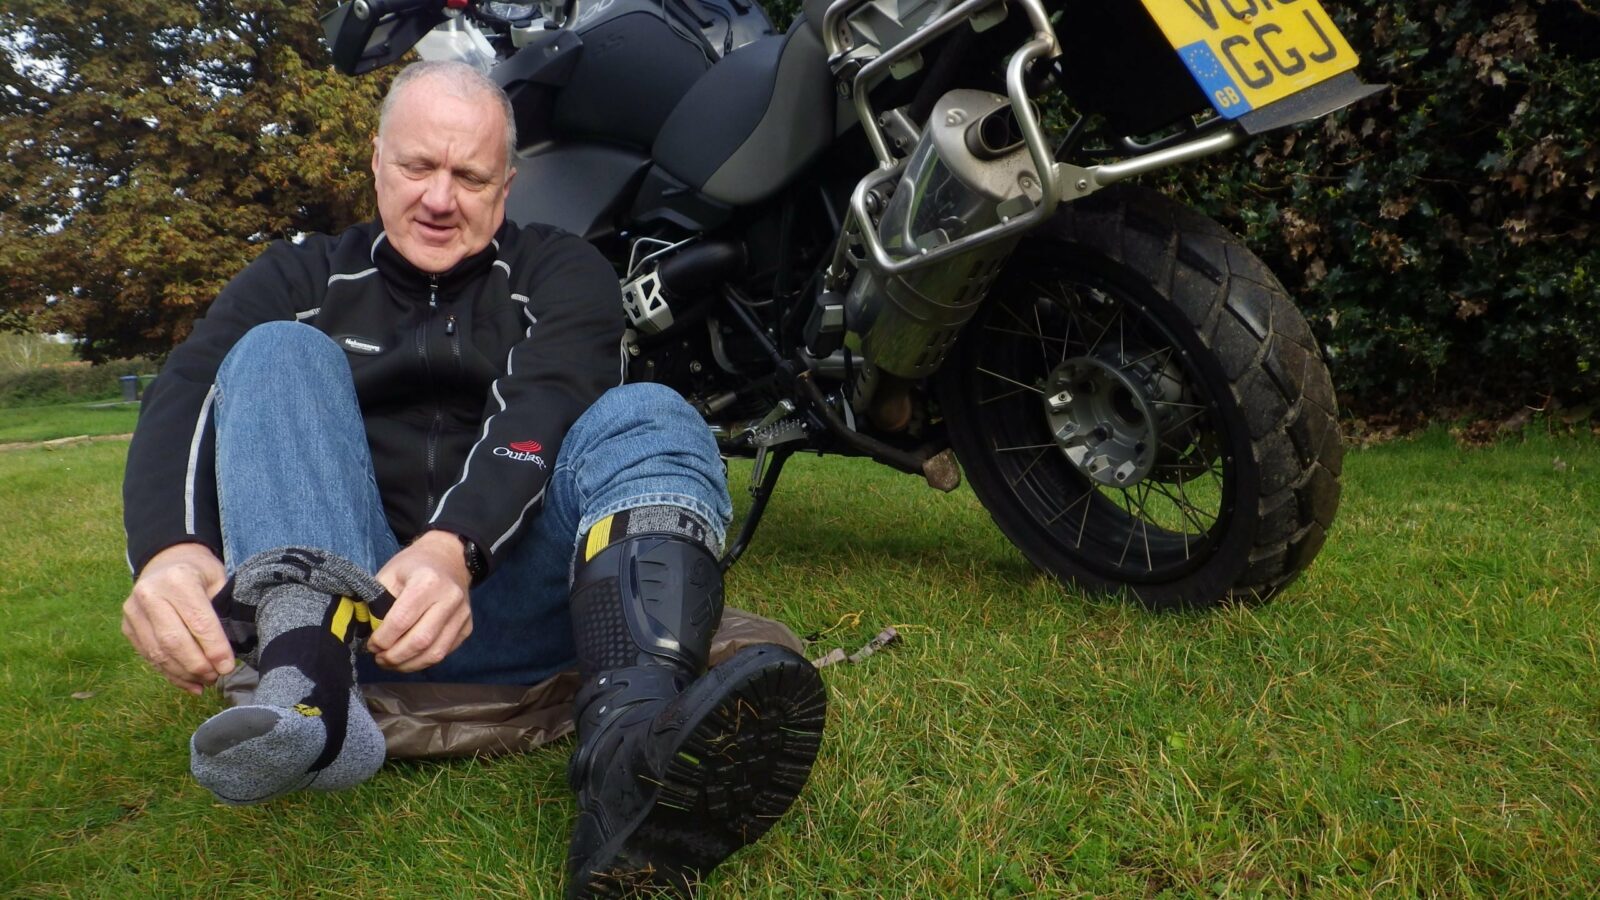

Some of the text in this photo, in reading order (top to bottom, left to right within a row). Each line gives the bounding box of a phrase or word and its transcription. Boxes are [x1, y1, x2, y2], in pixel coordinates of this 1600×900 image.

[1220, 9, 1337, 89] GGJ
[1214, 86, 1241, 108] GB
[493, 446, 546, 470] Outlast
